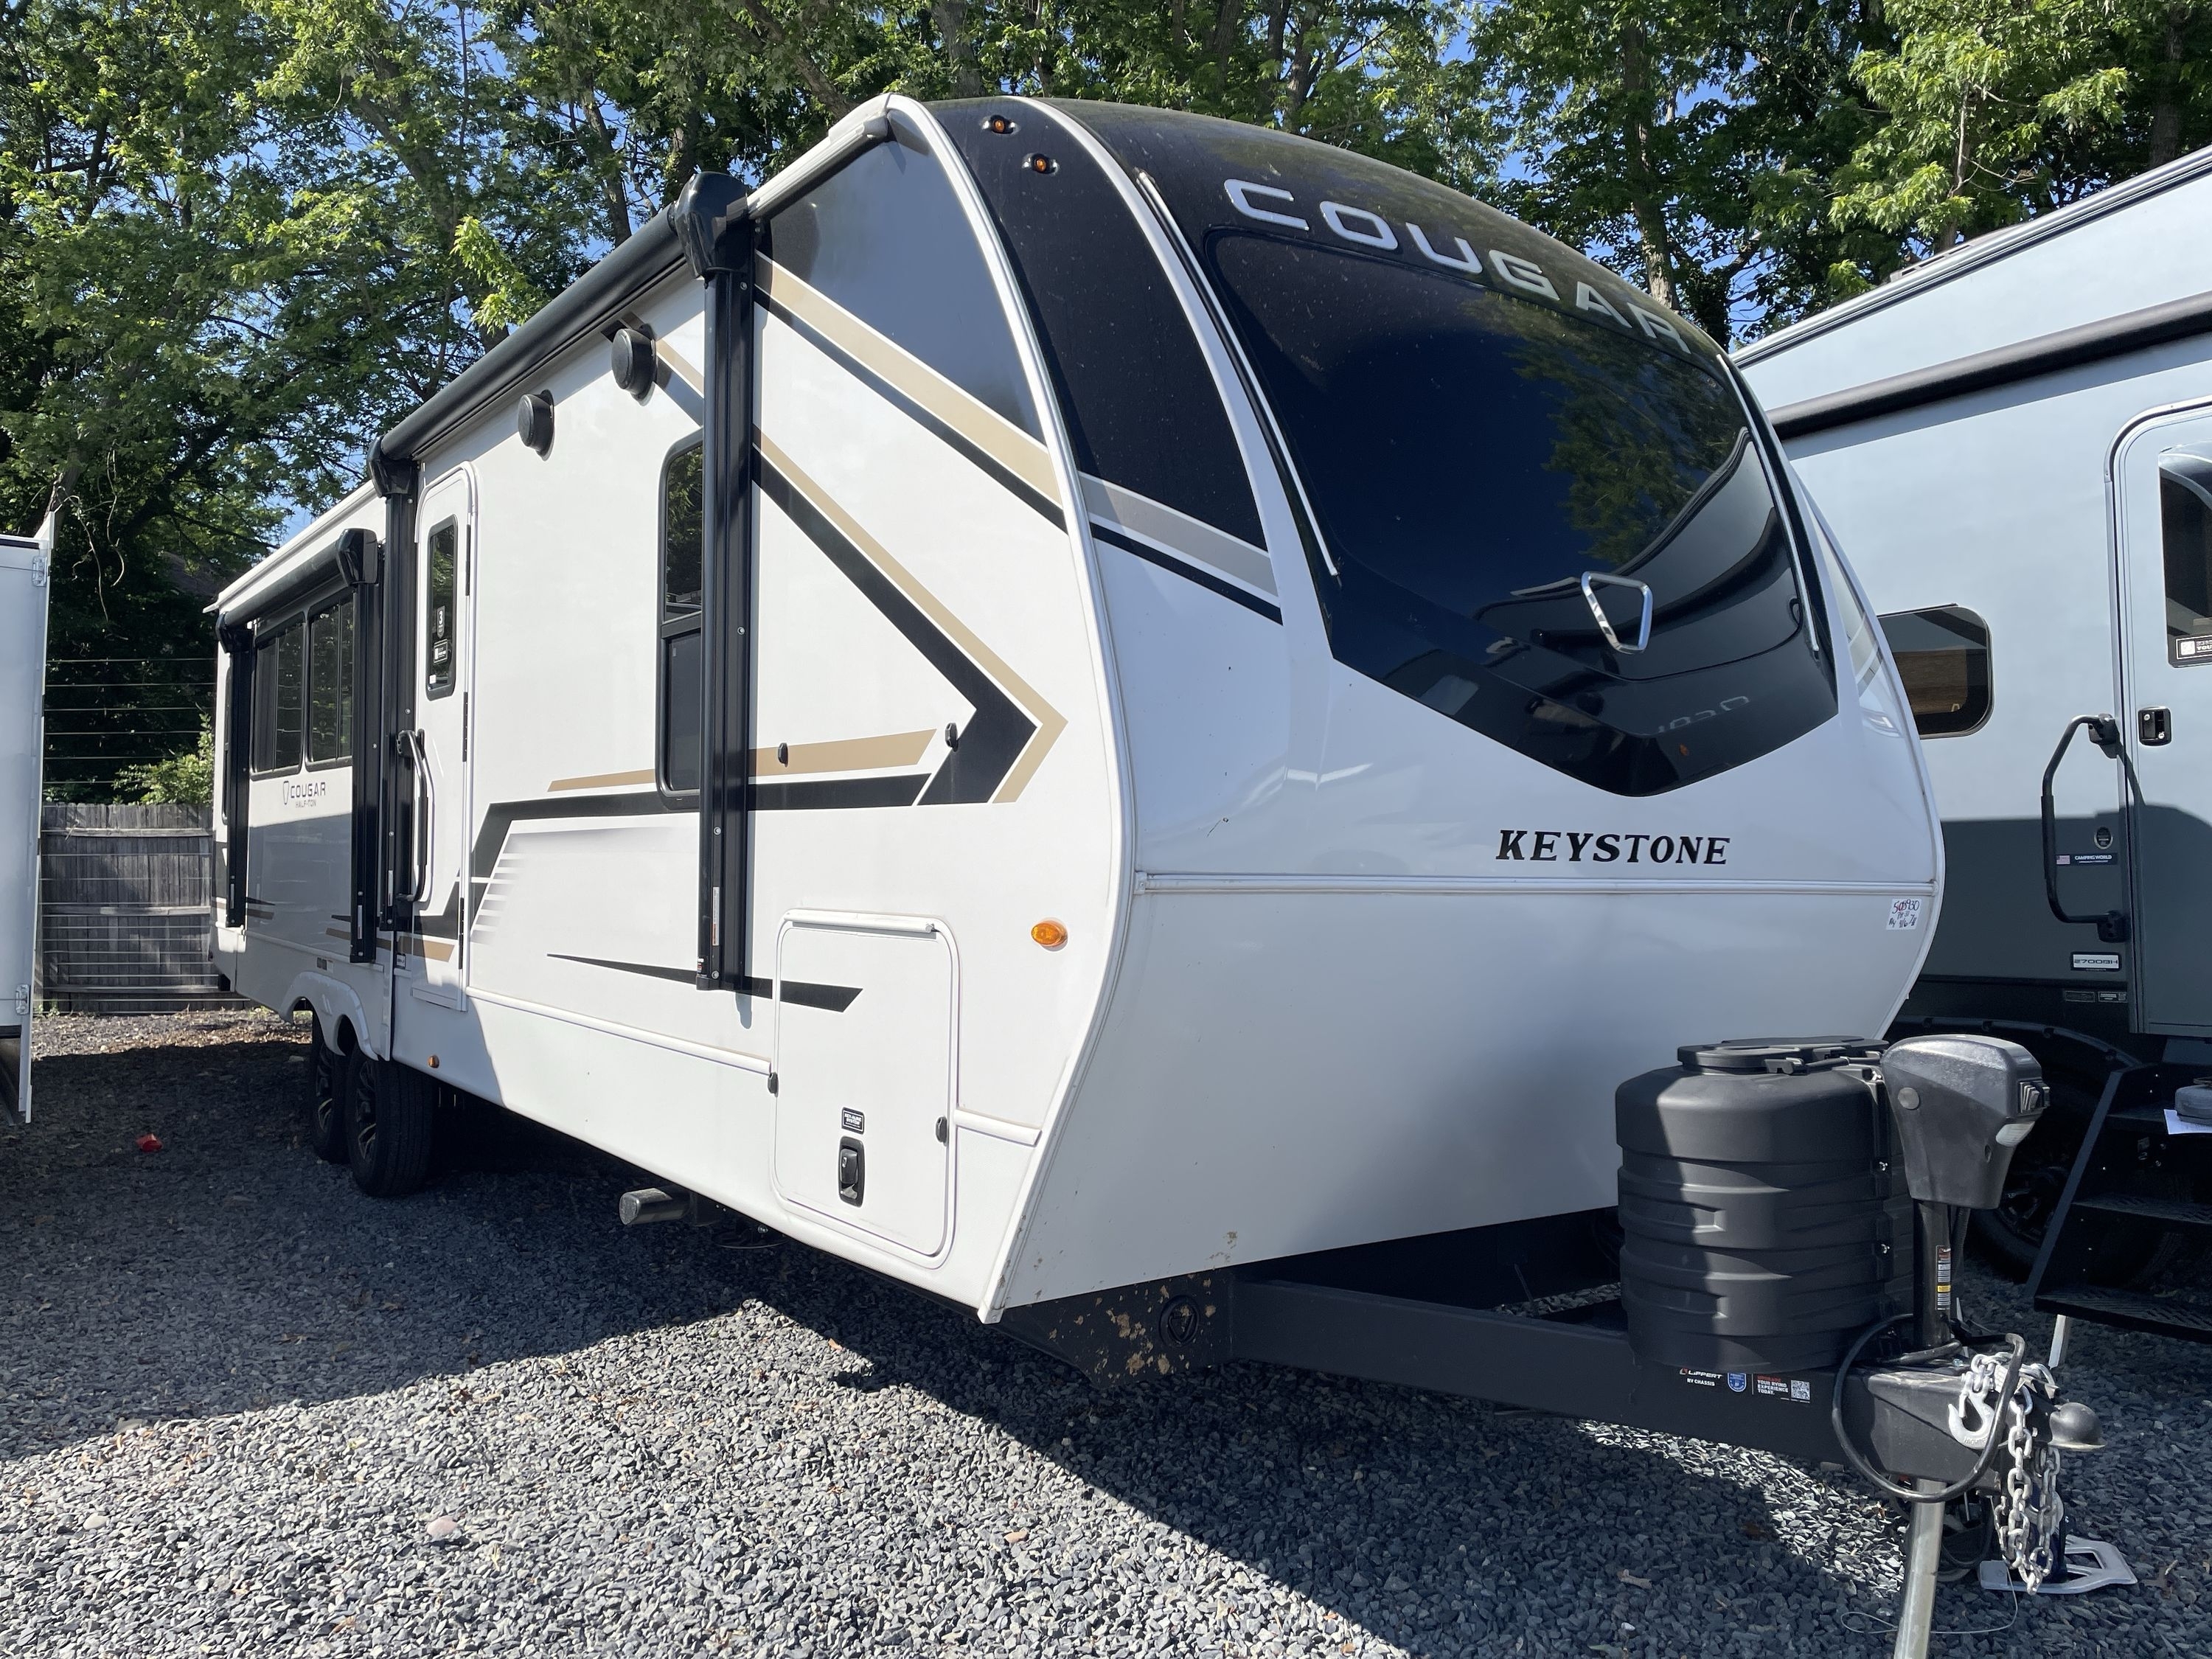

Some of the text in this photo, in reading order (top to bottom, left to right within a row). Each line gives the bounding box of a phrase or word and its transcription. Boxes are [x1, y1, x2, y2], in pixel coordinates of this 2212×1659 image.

[1224, 178, 1691, 354] COUGAR
[291, 782, 326, 799] COUGAR
[1495, 830, 1731, 865] KEYSTONE
[1688, 1370, 1725, 1379] LIPPERT
[1757, 1384, 1789, 1393] EXPERIENCE
